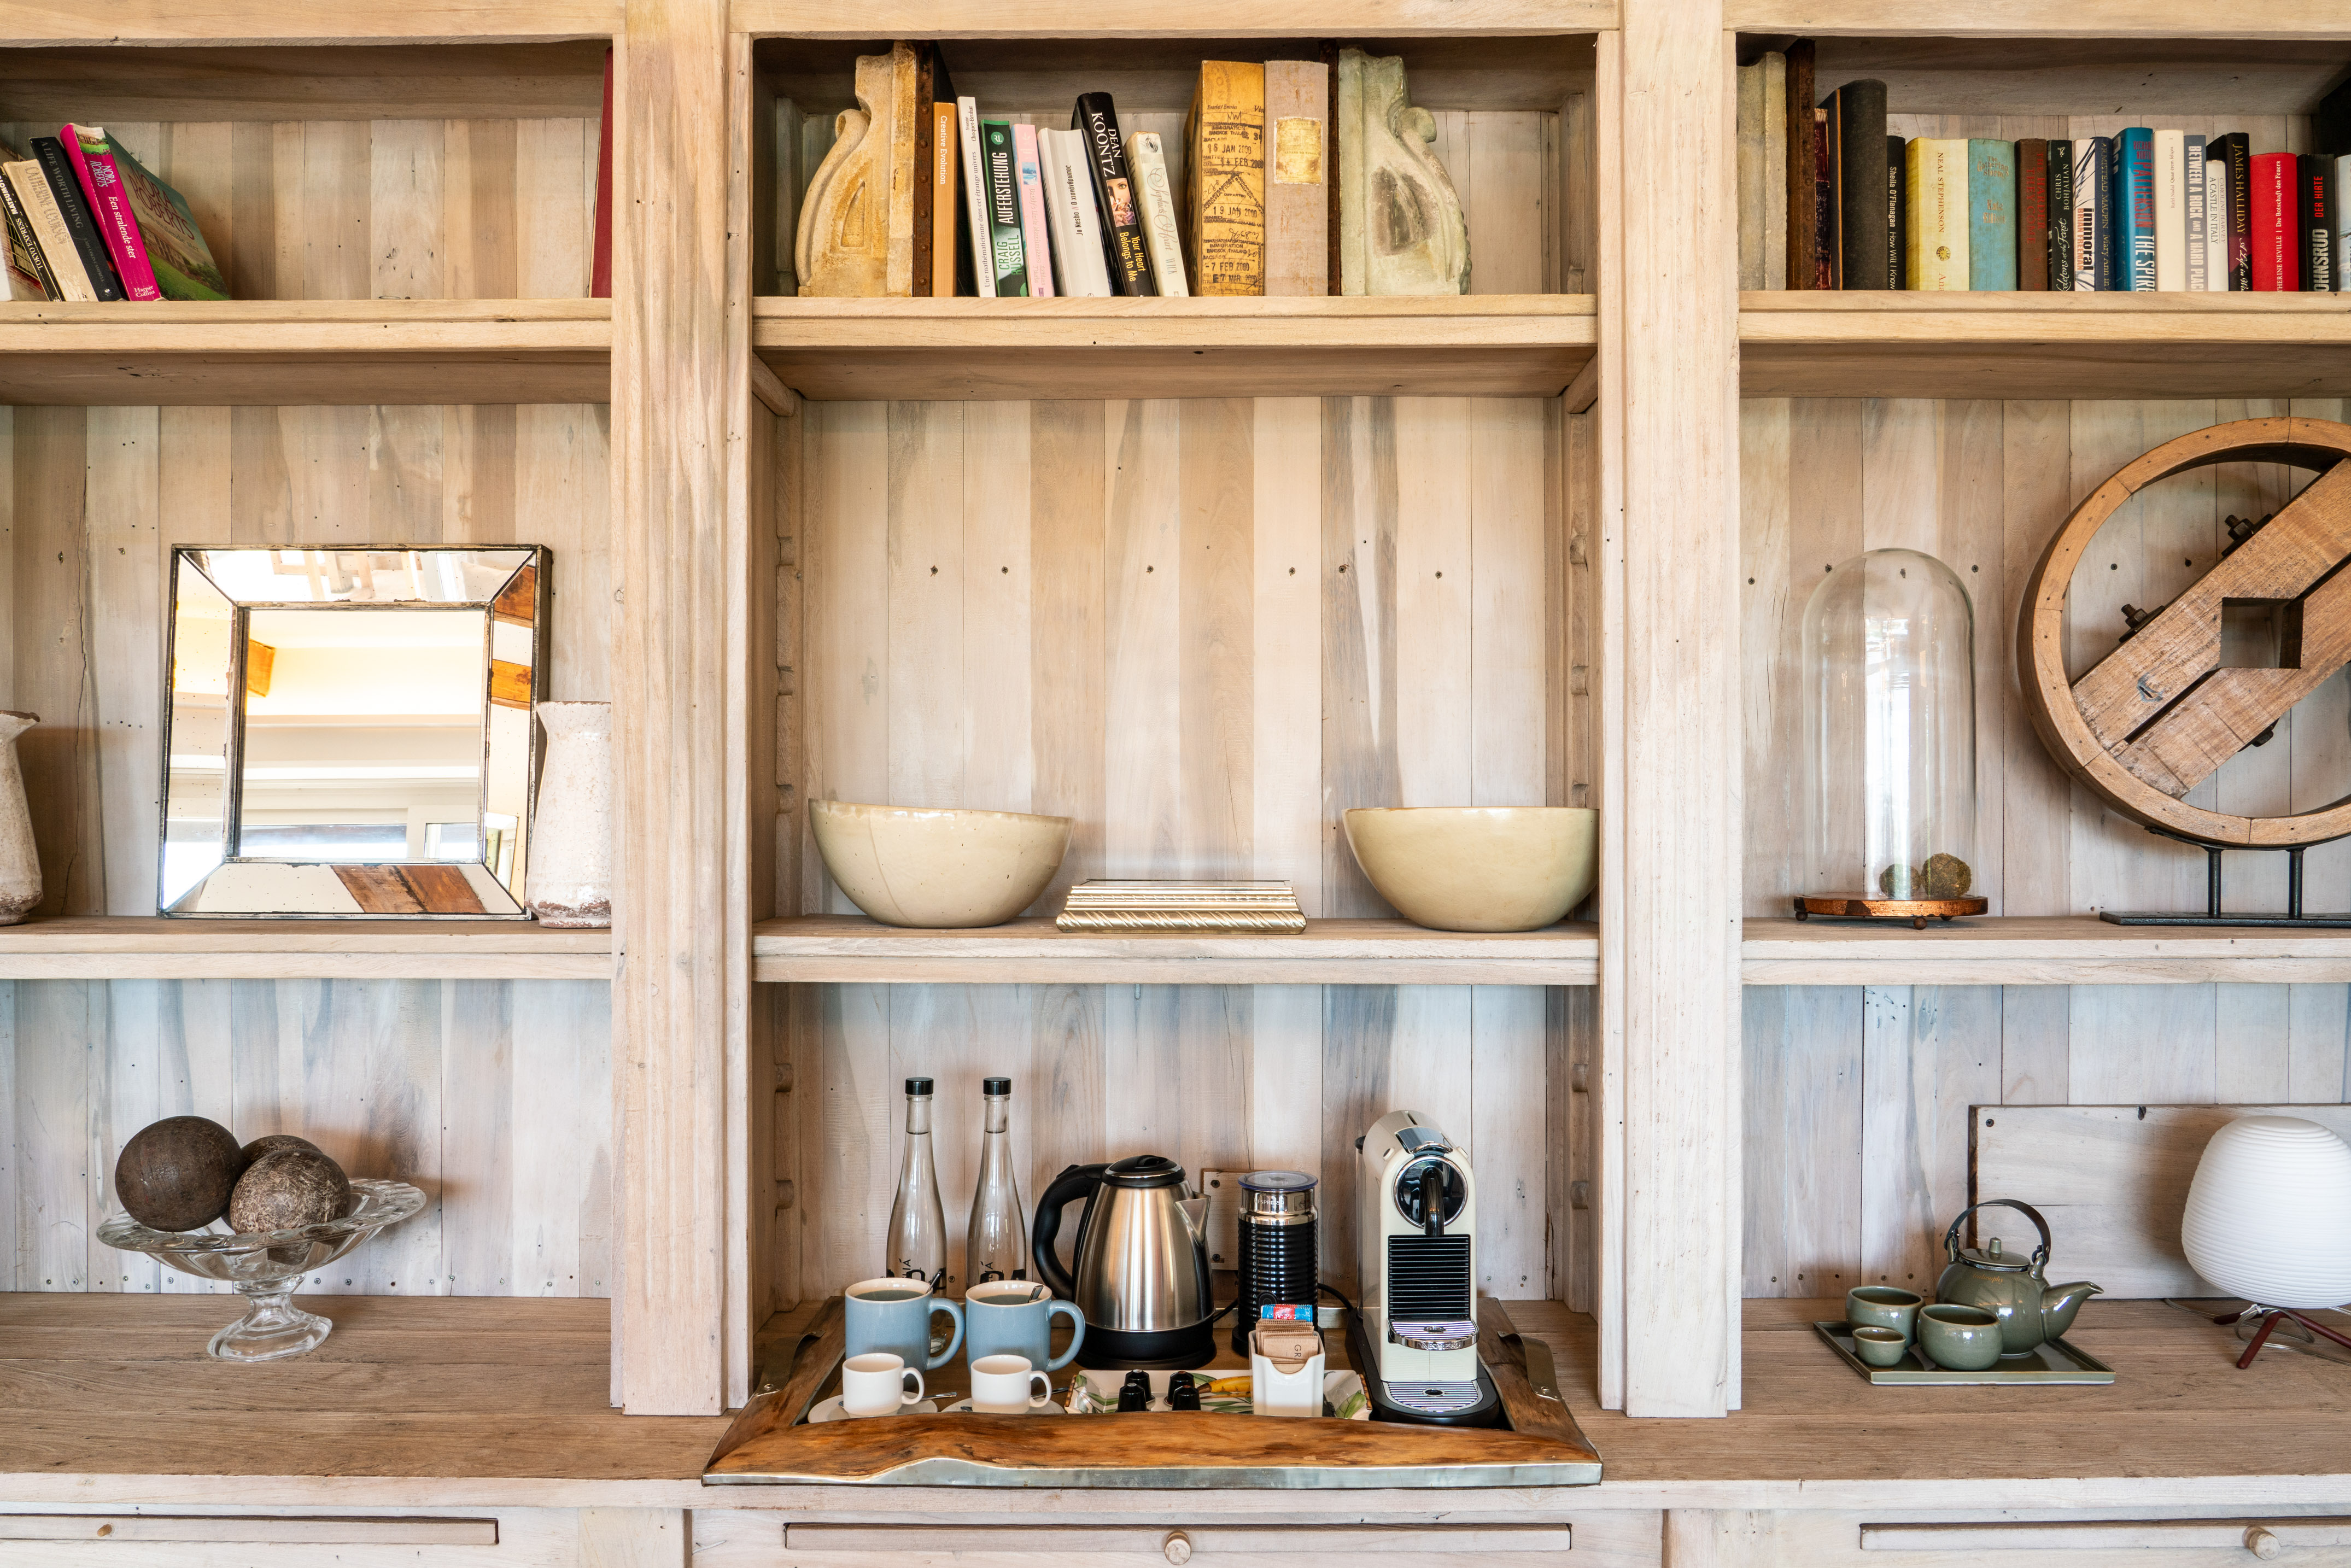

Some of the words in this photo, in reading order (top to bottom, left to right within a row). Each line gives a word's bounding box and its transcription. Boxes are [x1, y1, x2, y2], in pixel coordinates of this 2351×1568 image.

[969, 106, 977, 142] Choquet-Bruhat
[1091, 112, 1116, 177] KOONTZ
[1108, 128, 1122, 158] DEAN
[1222, 144, 1236, 153] JAN
[1238, 144, 1251, 154] 2000
[90, 160, 108, 188] ROBERTS
[1235, 157, 1248, 167] FEB
[1977, 161, 2009, 176] Gathering
[2189, 145, 2202, 184] BETWEEN
[2232, 144, 2244, 179] JAMES
[25, 166, 52, 207] CATHERINE
[102, 165, 116, 184] NORA
[2026, 167, 2036, 202] THEY
[44, 148, 57, 166] LIFE
[53, 166, 71, 200] WORTH
[66, 196, 84, 229] LIVING
[129, 163, 178, 214] NORA
[992, 152, 1014, 224] AUFERSTEHUNG
[1147, 167, 1169, 216] Sophie's
[2133, 162, 2154, 227] PATTERSON
[2209, 183, 2218, 208] CASTLE
[2313, 176, 2323, 199] HIRTE
[108, 196, 119, 210] Een
[127, 173, 195, 241] ROBERTS
[1228, 207, 1242, 217] JAN
[1888, 190, 1897, 227] O'Flanagan
[1987, 199, 2004, 211] Kate
[2037, 178, 2046, 230] HARDER
[2190, 195, 2203, 219] ROCK
[2210, 210, 2218, 220] IN
[2236, 182, 2246, 234] HALLIDAY
[2314, 202, 2324, 217] DER
[113, 211, 131, 244] stralende
[1983, 212, 2006, 224] Elliott
[2026, 206, 2036, 245] COME
[2192, 221, 2201, 232] AND
[15, 218, 34, 247] EXPRESS
[1076, 227, 1083, 236] Jo
[1131, 236, 1140, 251] Your
[1154, 212, 1178, 251] Heart
[2054, 218, 2070, 248] Feast
[2084, 208, 2094, 270] immoral
[125, 243, 136, 259] ster
[979, 223, 989, 272] mathématicienne
[997, 242, 1010, 270] CRAIG
[1008, 235, 1022, 275] RUSSELL
[1033, 226, 1042, 263] Matchmakers
[1119, 231, 1132, 261] Belongs
[2135, 235, 2155, 255] THE
[2190, 242, 2204, 265] HARD
[27, 246, 43, 271] TOKYO
[1126, 260, 1133, 270] to
[1134, 252, 1146, 272] Heart
[1166, 258, 1177, 274] WICK
[1220, 262, 1233, 271] FEB
[1236, 262, 1249, 271] 2000
[2236, 249, 2248, 268] Life
[1128, 270, 1138, 282] Me
[2104, 278, 2109, 286] in
[2239, 268, 2246, 277] in
[134, 285, 154, 294] Harper
[136, 290, 155, 299] Collins
[1972, 1272, 2004, 1284] tealosophy
